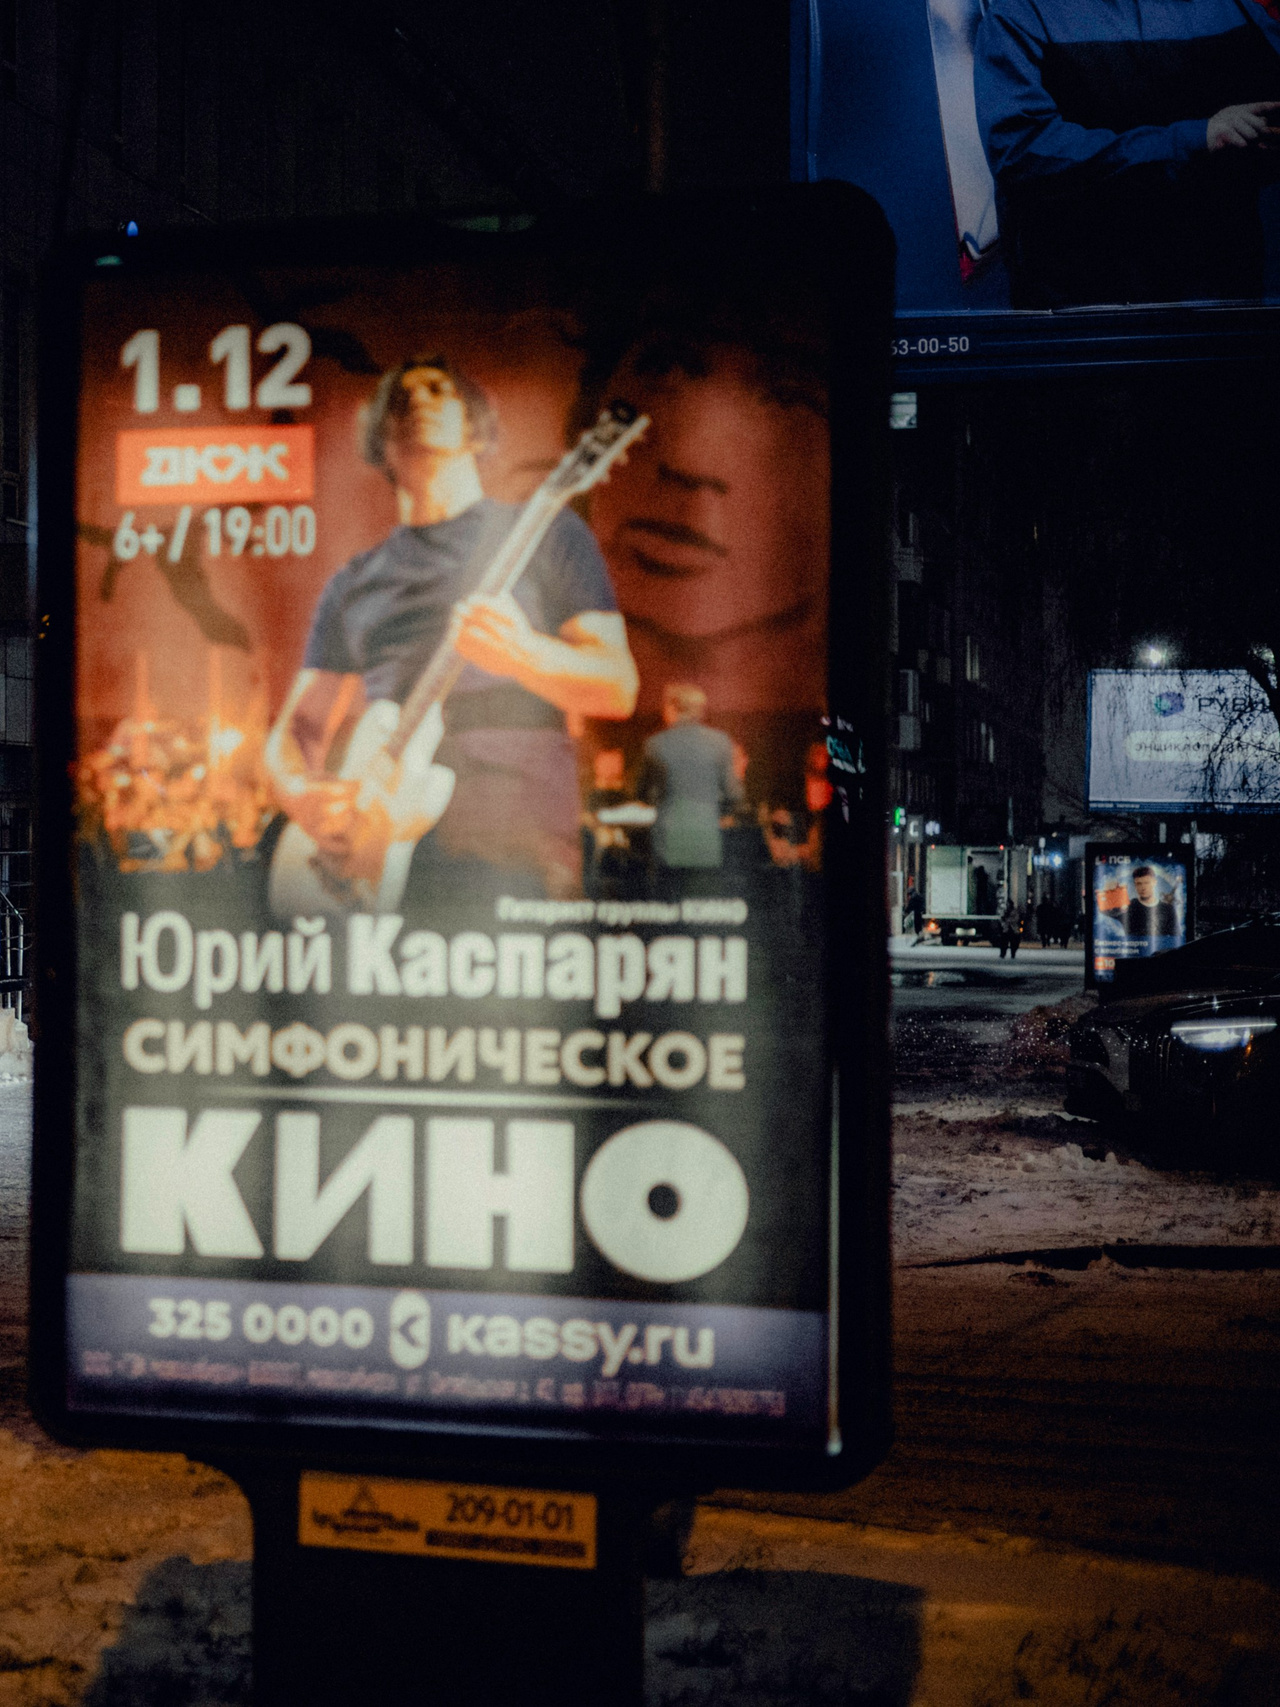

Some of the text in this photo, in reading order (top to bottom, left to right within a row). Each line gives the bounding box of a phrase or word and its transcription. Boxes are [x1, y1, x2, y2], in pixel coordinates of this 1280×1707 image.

[121, 321, 312, 414] 1.12
[204, 505, 317, 557] 19:00
[121, 911, 749, 1018] Юрий Каспарян
[122, 1018, 747, 1091] СИМФОНИЧЕСКОЕ
[121, 1106, 751, 1284] КИНО
[147, 1297, 716, 1379] 325 0000 kassy.ru
